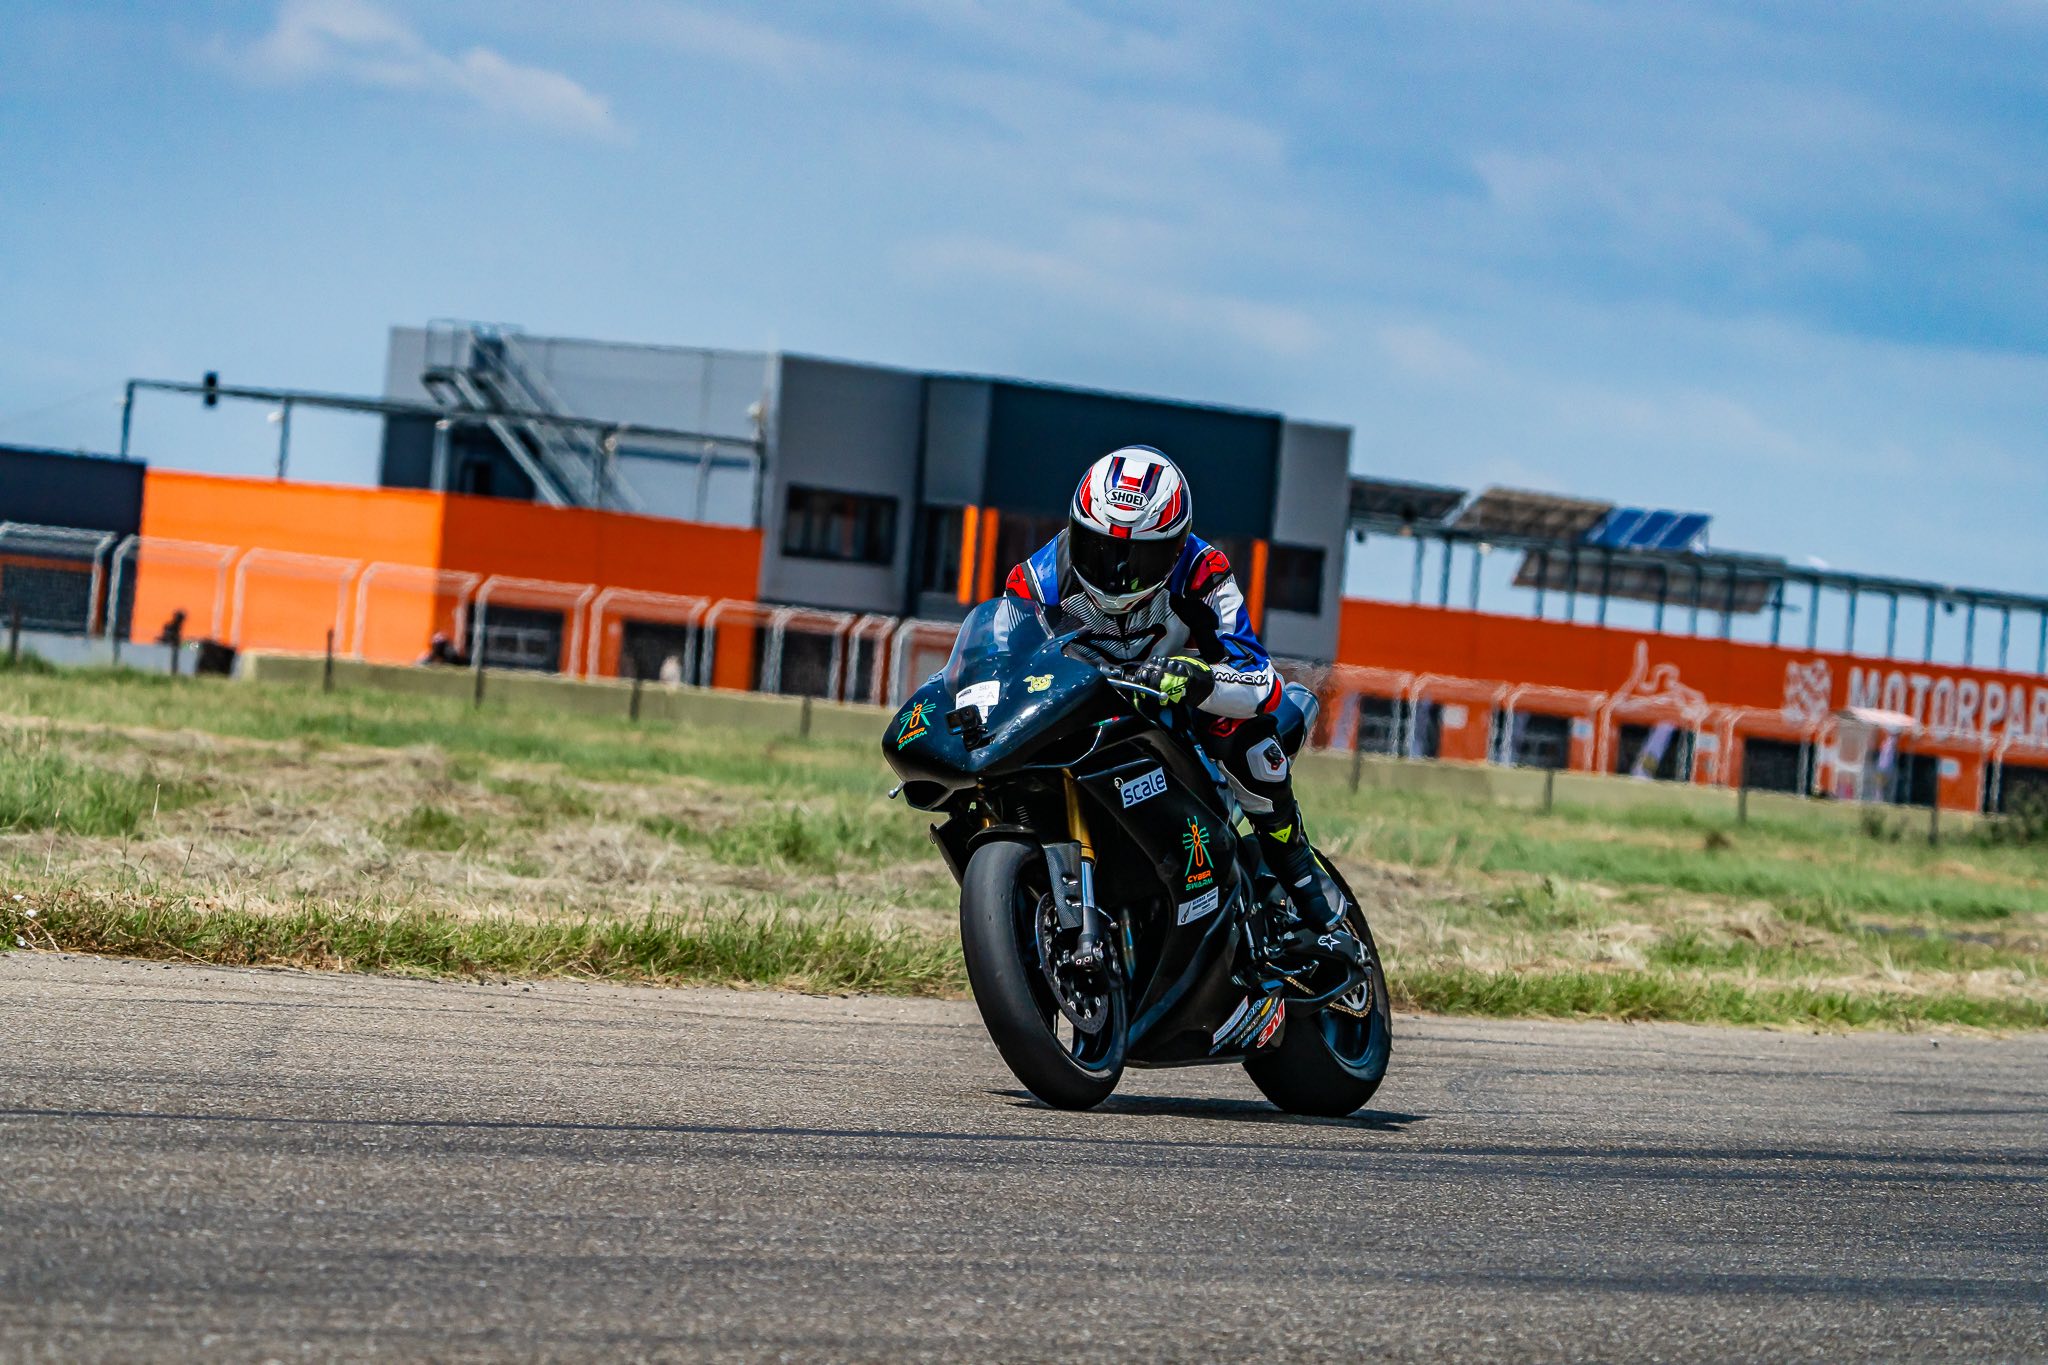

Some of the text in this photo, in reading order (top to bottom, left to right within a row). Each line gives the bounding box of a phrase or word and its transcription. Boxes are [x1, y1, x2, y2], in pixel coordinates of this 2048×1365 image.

[1111, 491, 1144, 506] SHOEI
[1123, 773, 1166, 805] scale
[1187, 870, 1212, 883] CYBER
[1185, 877, 1213, 891] SWARM
